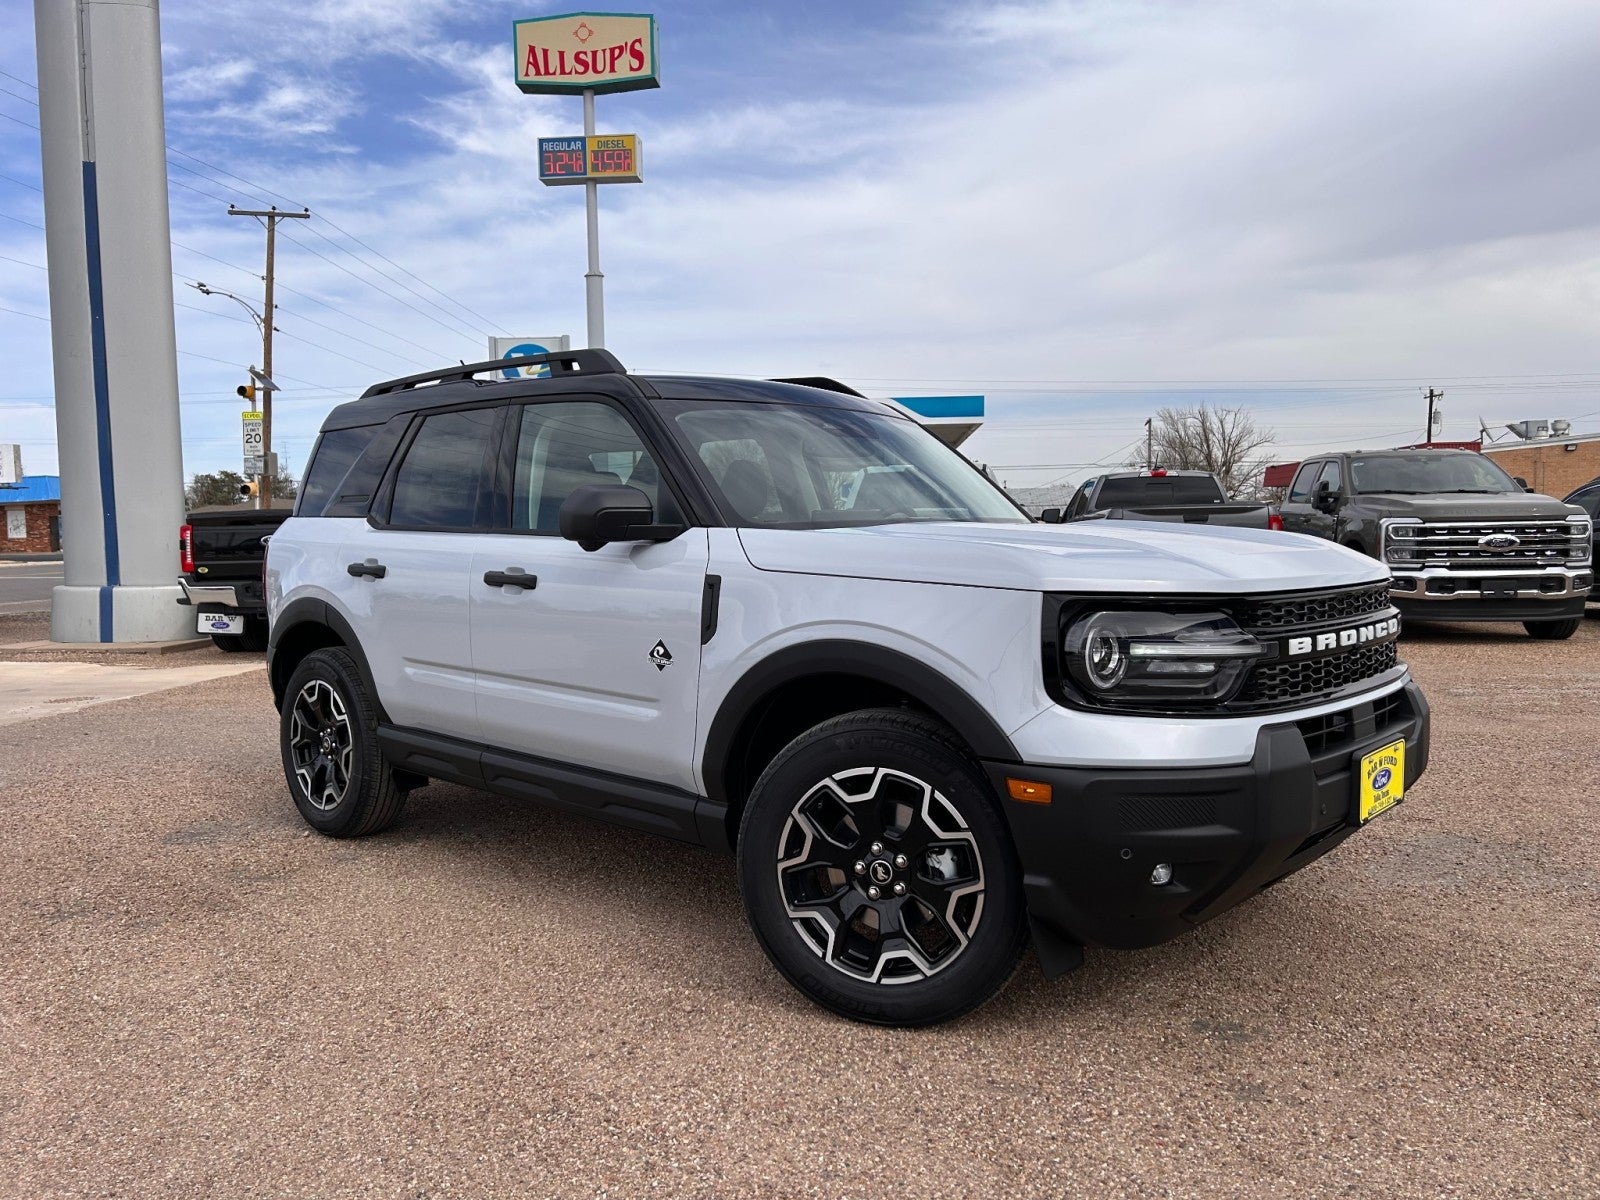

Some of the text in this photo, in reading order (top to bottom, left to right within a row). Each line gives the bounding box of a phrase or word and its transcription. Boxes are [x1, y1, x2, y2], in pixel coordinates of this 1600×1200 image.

[524, 38, 644, 76] ALLSUP'S
[542, 141, 582, 151] REGULAR
[597, 139, 626, 149] DIESEL
[246, 434, 261, 443] 20
[1288, 618, 1398, 655] BRONCO
[1384, 756, 1397, 766] FORD
